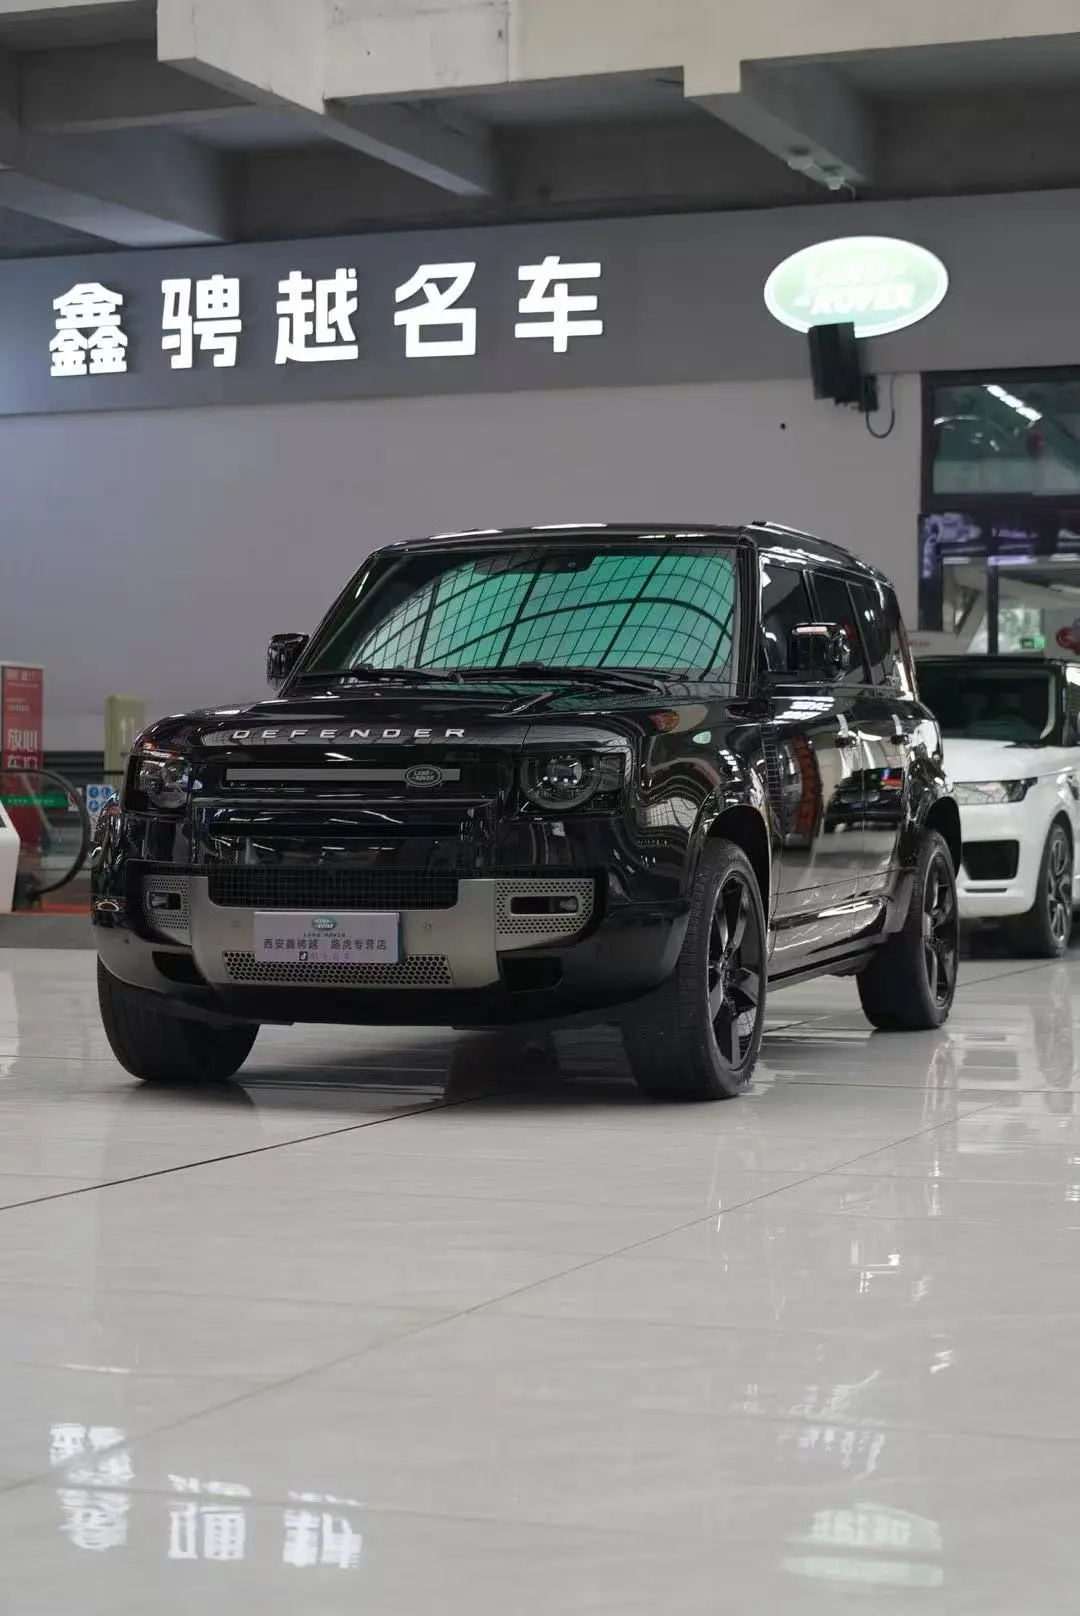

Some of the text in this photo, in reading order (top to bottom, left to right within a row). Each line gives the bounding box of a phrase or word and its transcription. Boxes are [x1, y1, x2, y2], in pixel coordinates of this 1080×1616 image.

[811, 284, 914, 314] ROVER
[49, 255, 603, 376] 鑫骋越名车
[232, 728, 465, 739] DEFENDER
[331, 938, 388, 950] 路虎专营店
